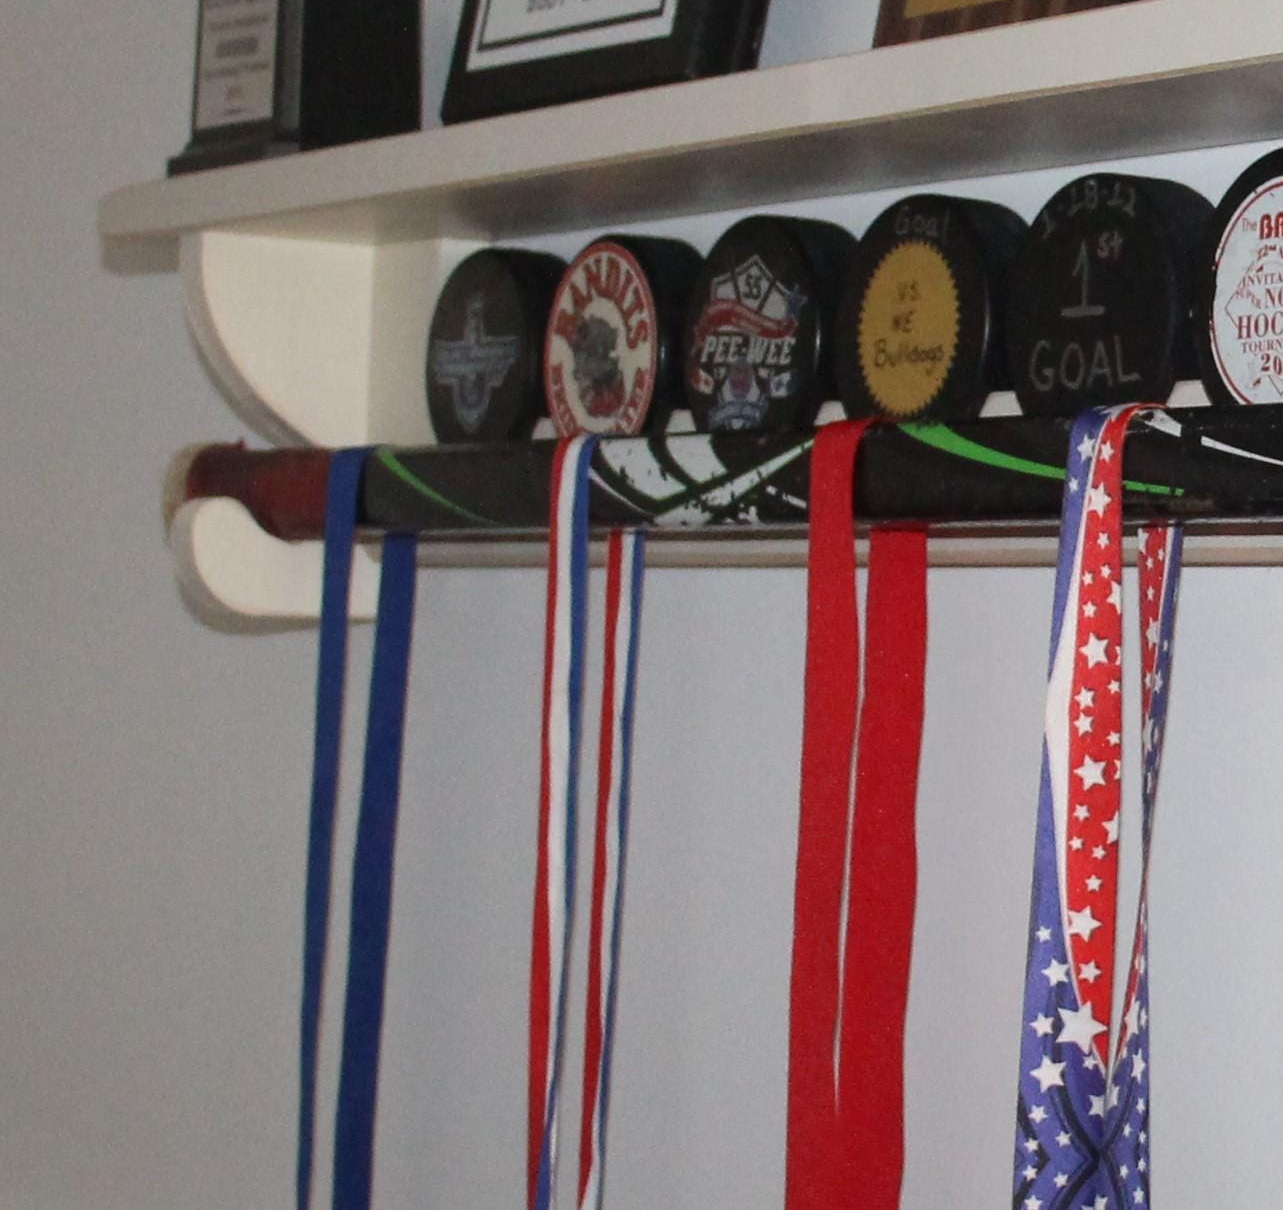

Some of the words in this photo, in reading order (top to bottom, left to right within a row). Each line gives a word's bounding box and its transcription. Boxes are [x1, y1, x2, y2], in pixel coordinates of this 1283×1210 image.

[895, 205, 950, 243] Goal
[555, 256, 649, 350] BANDITS
[700, 335, 796, 366] PEE-WEE
[873, 337, 945, 377] Bulldogs
[1028, 335, 1143, 392] GOAL
